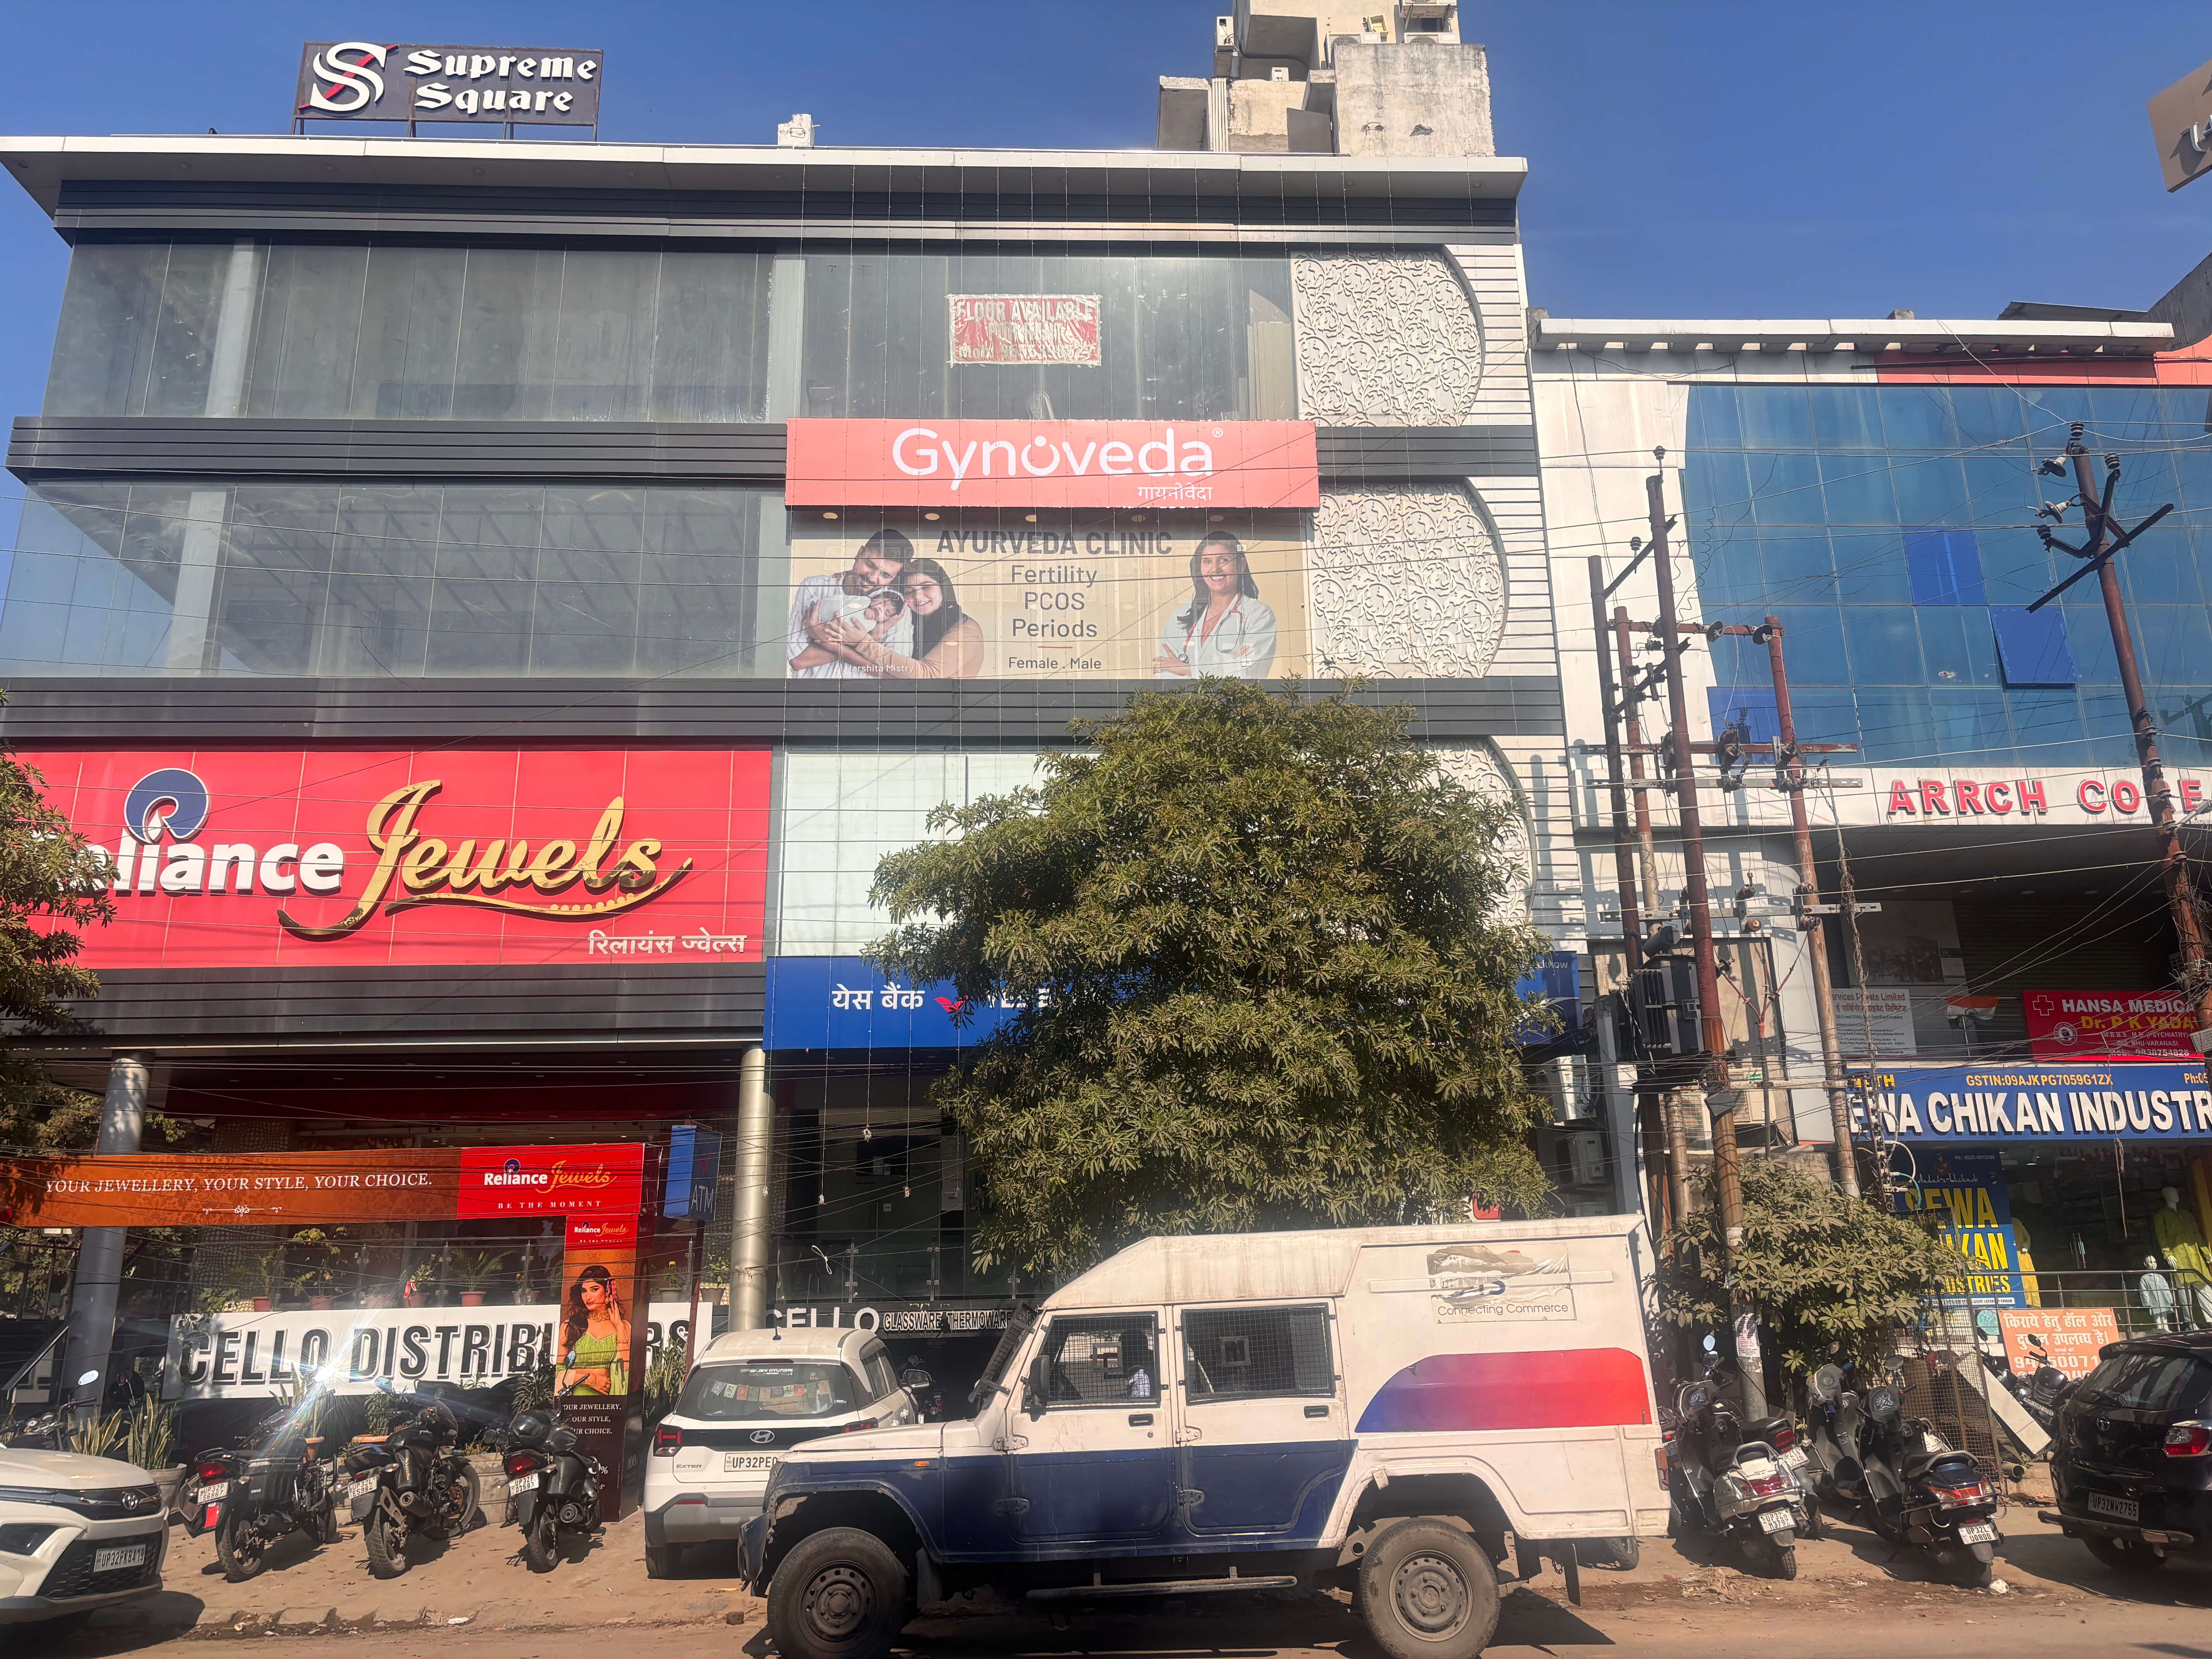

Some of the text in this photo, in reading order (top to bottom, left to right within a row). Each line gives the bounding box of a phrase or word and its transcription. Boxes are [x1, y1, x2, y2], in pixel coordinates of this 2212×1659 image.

[404, 49, 597, 80] Supreme
[414, 82, 574, 114] Square
[956, 301, 1006, 321] FLOOR
[893, 428, 1213, 490] Gynoveda
[1137, 482, 1213, 501] गायनोवेदा
[937, 531, 1172, 555] AYURVEDA CLINIC
[1011, 565, 1097, 588] Fertility
[1024, 592, 1085, 611] PCOS
[1012, 619, 1098, 638] Periods
[886, 664, 914, 673] Mistry
[1008, 657, 1102, 669] Female Male
[1888, 778, 2203, 815] ARRCH COE
[31, 778, 663, 935] eliance Jewels
[588, 927, 747, 955] रिलायंस ज्वेल्स
[831, 982, 926, 1010] येस बैंक
[1832, 993, 1854, 1001] ervices
[1881, 993, 1905, 1001] Limited
[2062, 999, 2195, 1013] HANSA MEDICA
[2081, 1016, 2198, 1029] Dr. P K YADA
[1928, 1091, 2065, 1132] CHIKAN
[46, 1173, 433, 1194] YOUR JEWELLERY, YOUR STYLE, YOUR CHOICE.
[484, 1160, 612, 1194] Reliance Jewels
[551, 1200, 602, 1209] MOMENT
[690, 1184, 714, 1214] ATM
[595, 1222, 627, 1237] Jewels
[766, 1307, 879, 1334] CELLO
[883, 1311, 943, 1331] GLASSWARE
[1437, 1304, 1568, 1316] Connecting Commerce
[2003, 1312, 2039, 1328] किराये
[2040, 1313, 2062, 1332] हेतु
[2063, 1312, 2087, 1328] हॉल
[2091, 1311, 2113, 1327] और
[180, 1320, 690, 1385] CELLO DISTRIBRS
[203, 1484, 224, 1494] UP32P
[352, 1479, 373, 1491] UP32L
[1966, 1525, 1989, 1535] UP32L
